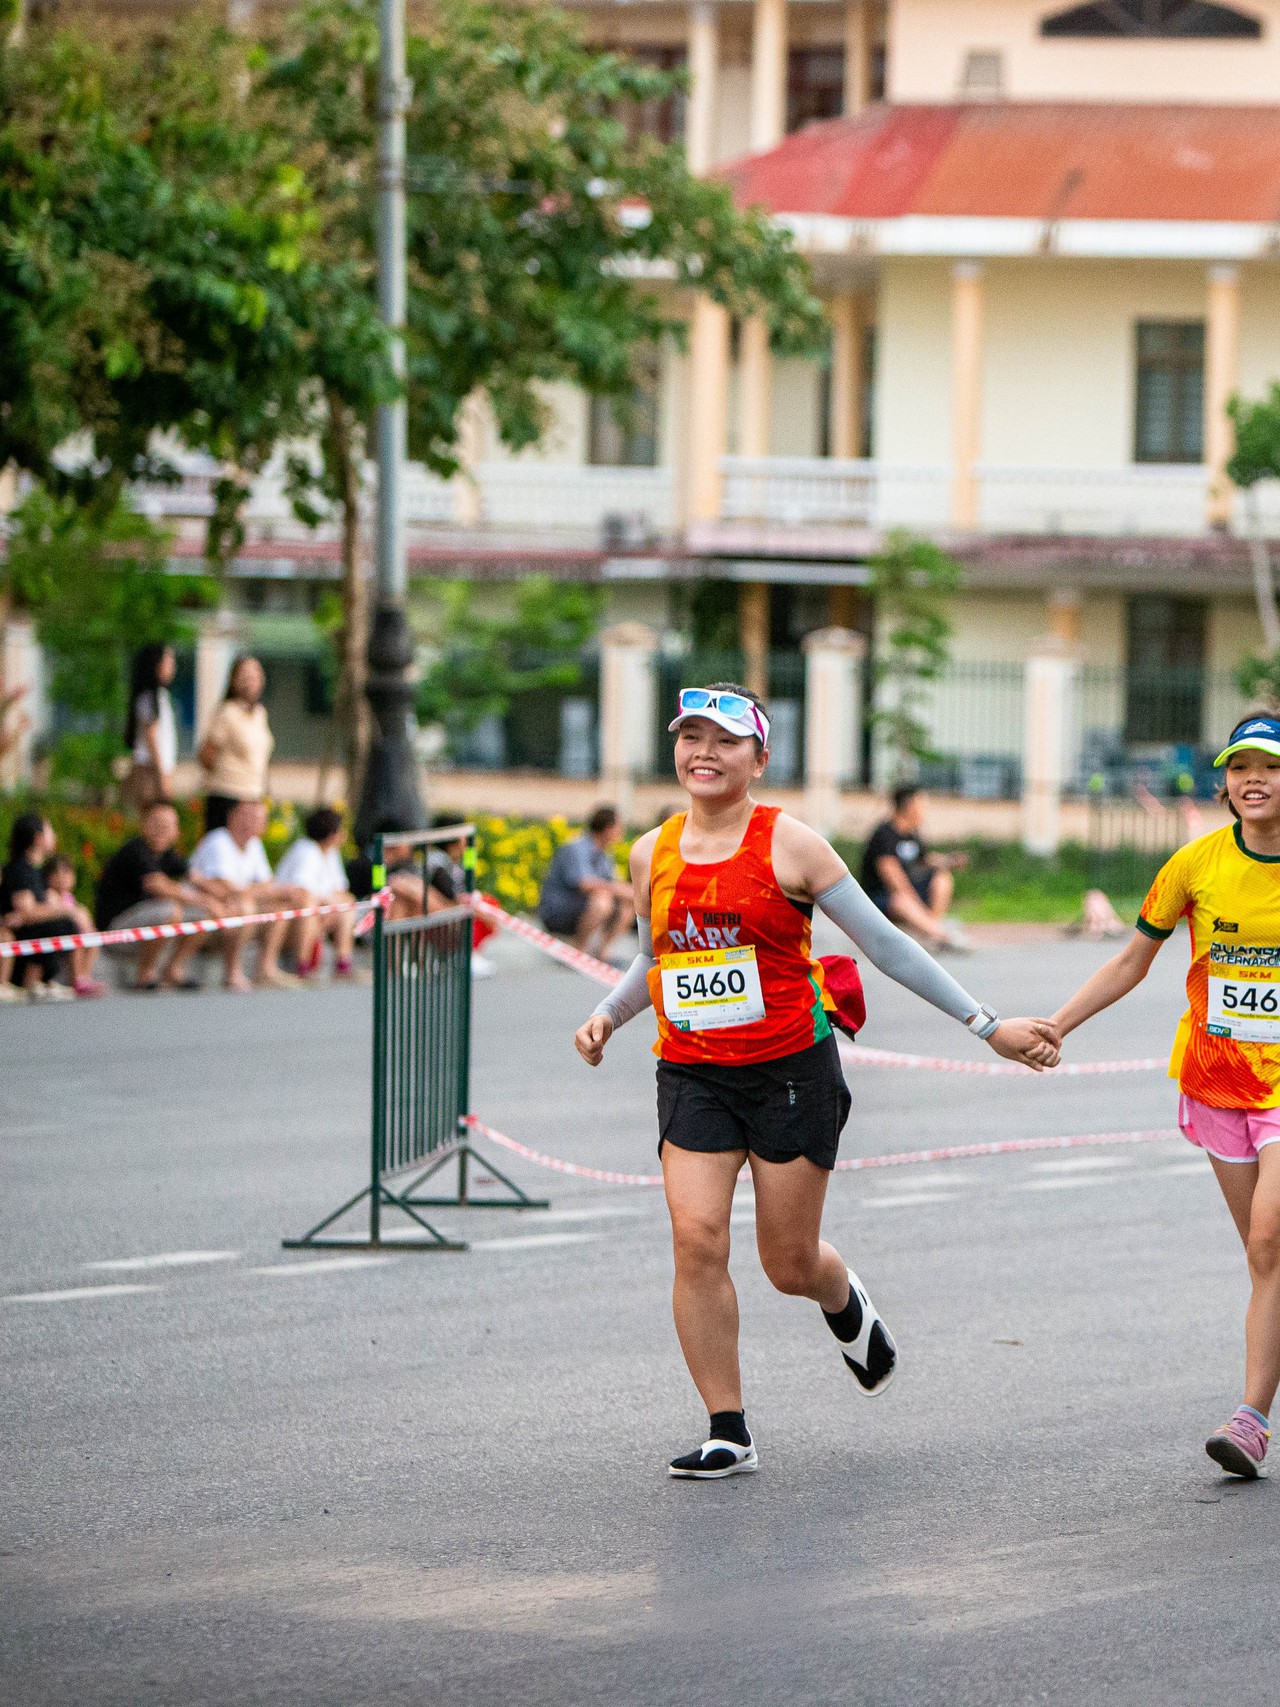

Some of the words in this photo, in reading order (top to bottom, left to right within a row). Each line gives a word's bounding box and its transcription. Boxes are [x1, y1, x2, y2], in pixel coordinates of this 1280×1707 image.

[702, 912, 742, 925] METRI
[668, 905, 742, 950] PARK
[687, 955, 714, 965] 5KM
[1238, 970, 1272, 979] 5KM
[676, 969, 746, 1000] 5460
